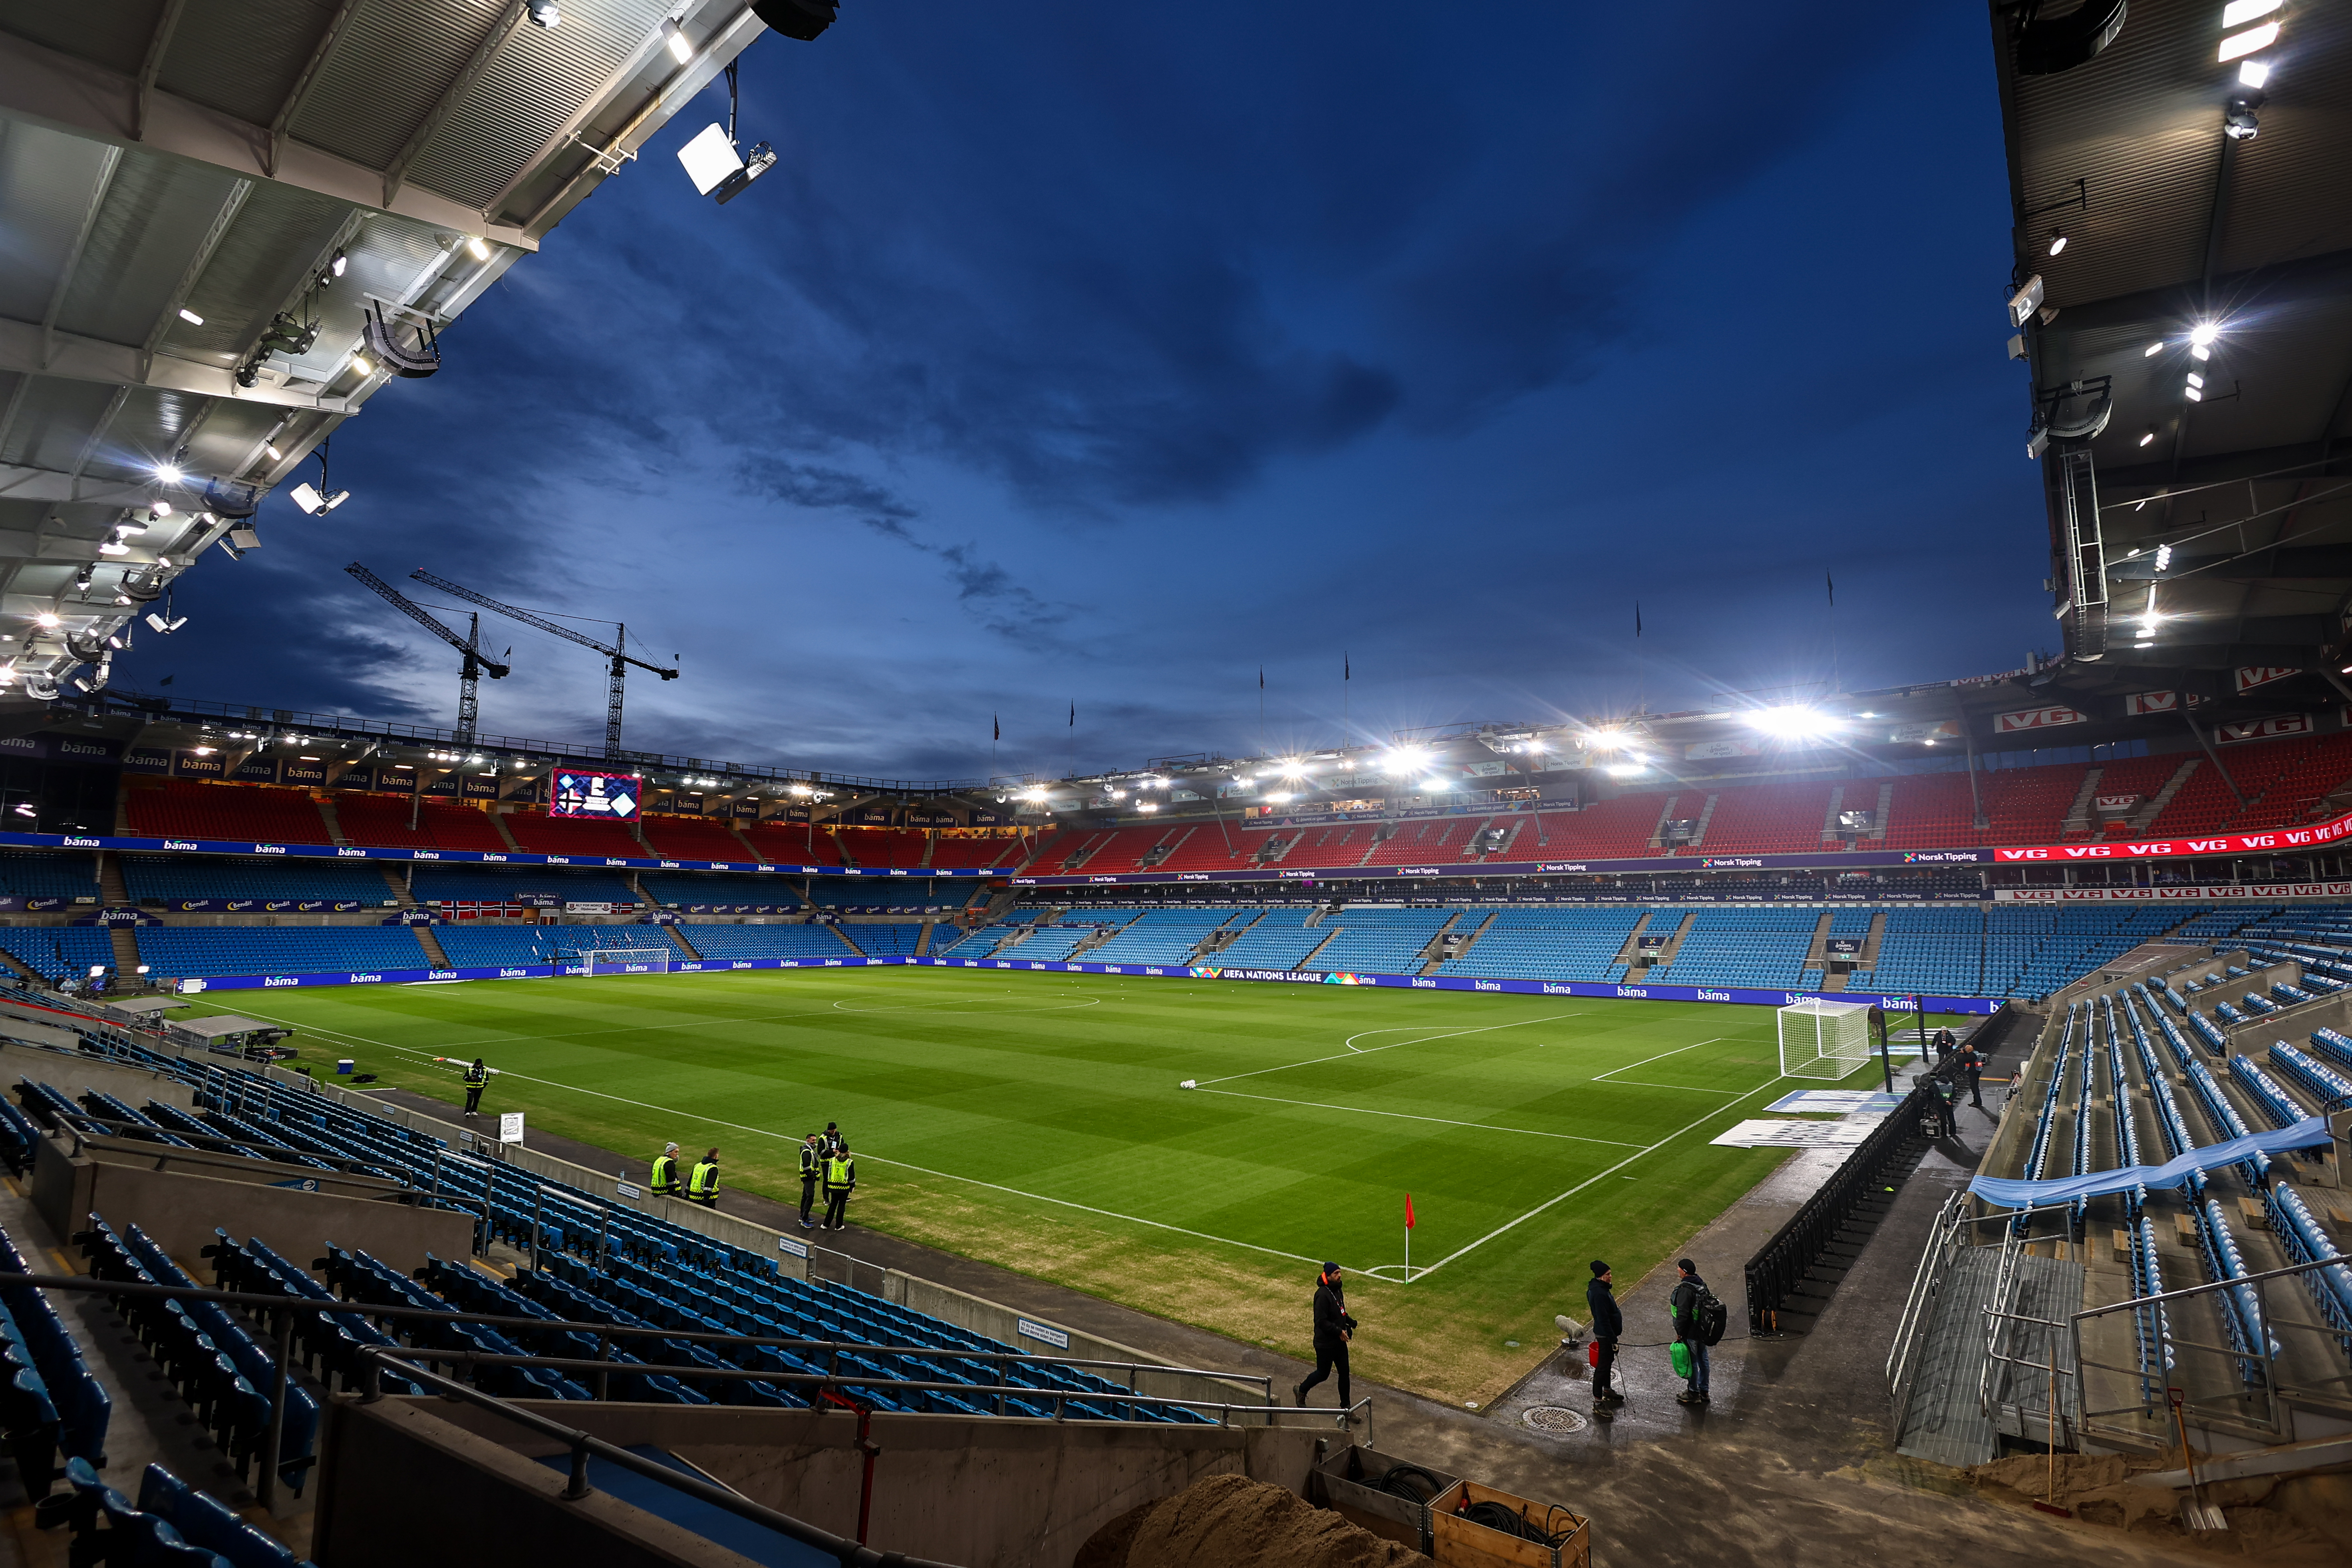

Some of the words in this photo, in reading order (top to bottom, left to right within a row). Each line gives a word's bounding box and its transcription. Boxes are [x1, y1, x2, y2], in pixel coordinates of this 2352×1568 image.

[2004, 708, 2073, 728] VG
[2221, 715, 2302, 739] VG
[61, 741, 105, 755] bama
[125, 753, 167, 766] bama
[183, 759, 220, 770] bama
[242, 766, 271, 774] ama
[288, 767, 322, 778] bama
[382, 775, 413, 786] bama
[467, 783, 495, 793] bama
[2315, 828, 2330, 839] VG
[2332, 823, 2342, 835] VG
[64, 837, 99, 846] bama
[2242, 836, 2274, 847] VG
[2286, 831, 2310, 843] VG
[164, 841, 197, 850] bama
[256, 845, 285, 853] bama
[2128, 844, 2171, 854] VG
[2187, 840, 2227, 851] VG
[338, 848, 366, 856] bama
[2002, 850, 2047, 859] VG
[2065, 847, 2110, 857] VG
[1735, 858, 1762, 867] Tipping
[1945, 853, 1977, 862] Tipping
[1421, 867, 1439, 876] Tipping
[2210, 888, 2243, 896] VG
[2254, 886, 2288, 896] VG
[2295, 885, 2321, 895] VG
[2328, 883, 2350, 894] VG
[101, 910, 137, 919] bama
[566, 965, 590, 974] bama
[351, 974, 381, 982] bama
[429, 971, 457, 979] bama
[1246, 971, 1284, 980] NATIONS
[1287, 972, 1321, 982] LEAGUE
[265, 977, 298, 986] bama
[1412, 978, 1435, 987] bama
[1476, 980, 1500, 990] bama
[1544, 983, 1570, 994] bama
[1618, 986, 1647, 997] bama
[1698, 989, 1729, 1000] bama
[1050, 1331, 1065, 1339] kampen?
